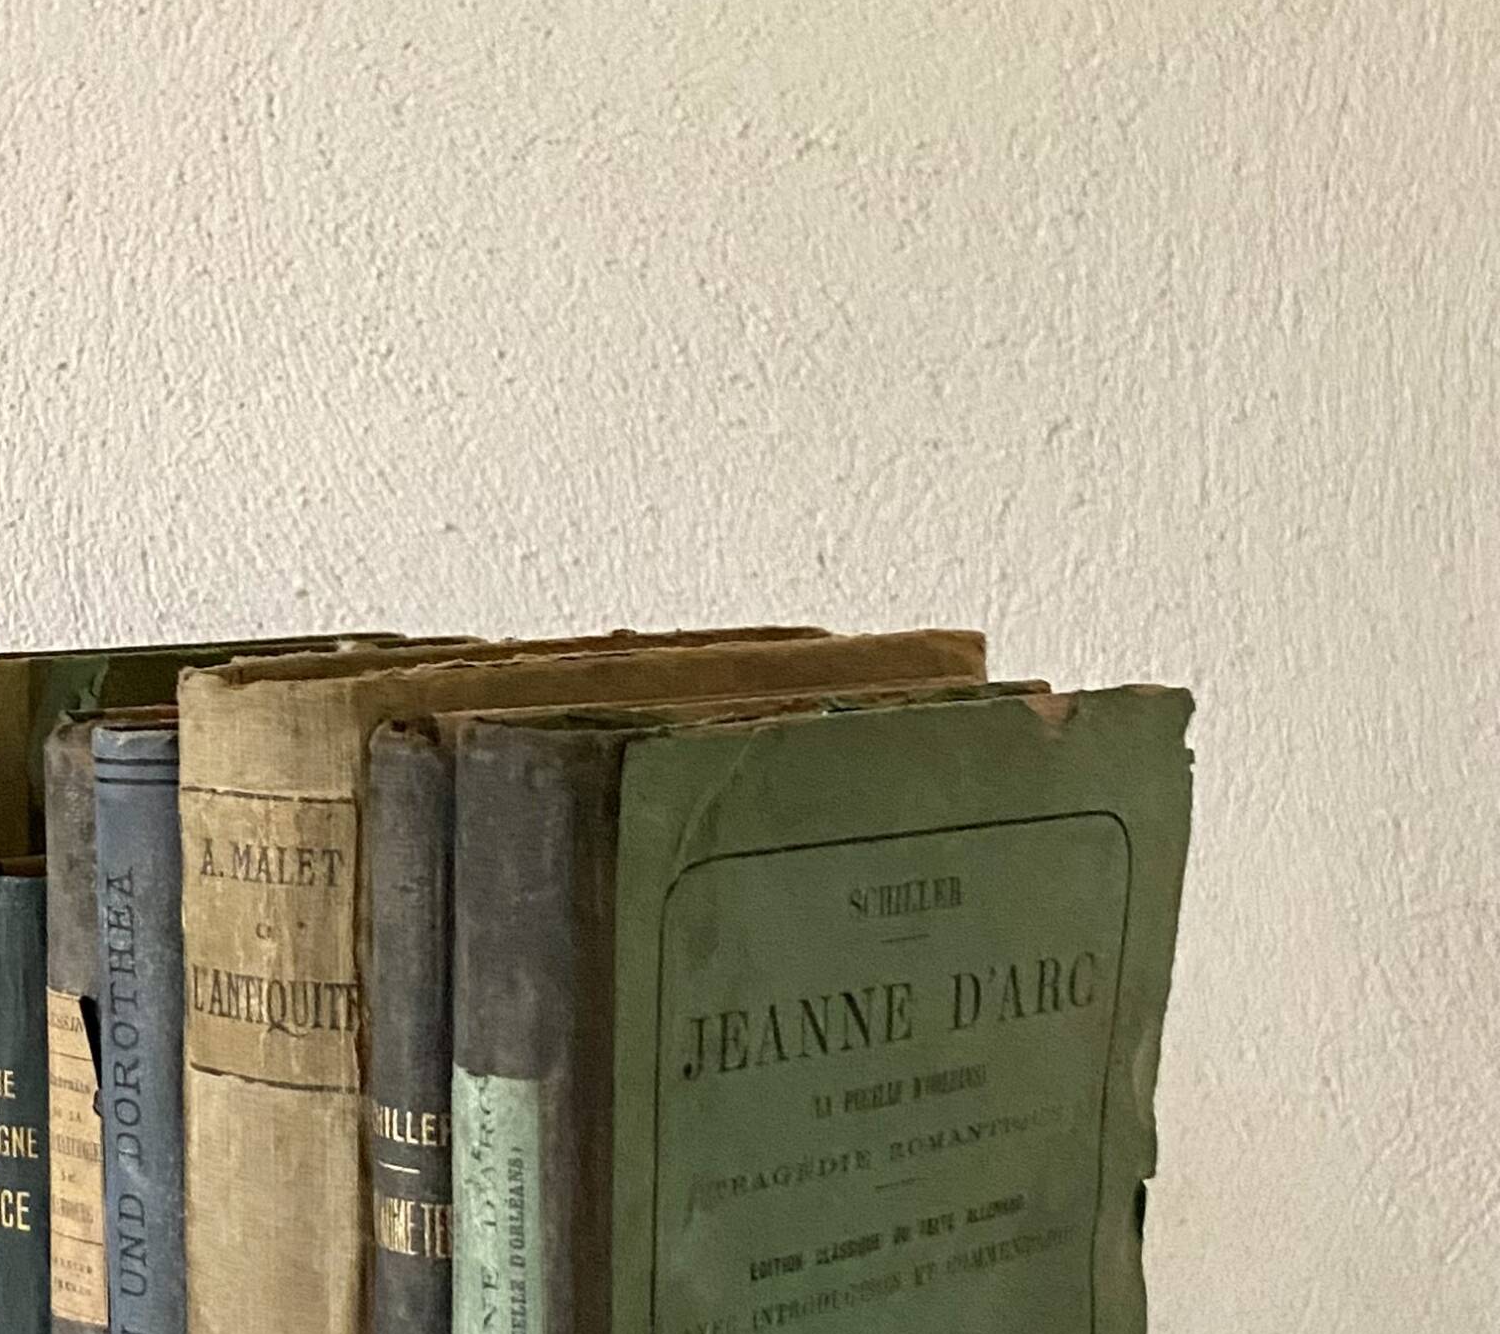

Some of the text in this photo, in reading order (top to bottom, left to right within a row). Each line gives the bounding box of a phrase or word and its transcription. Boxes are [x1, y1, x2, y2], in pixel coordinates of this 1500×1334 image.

[849, 875, 962, 918] SCHILLER
[107, 868, 142, 1168] DOROTHEA
[683, 952, 1096, 1081] JEANNE D'ARC
[118, 1193, 148, 1298] UND
